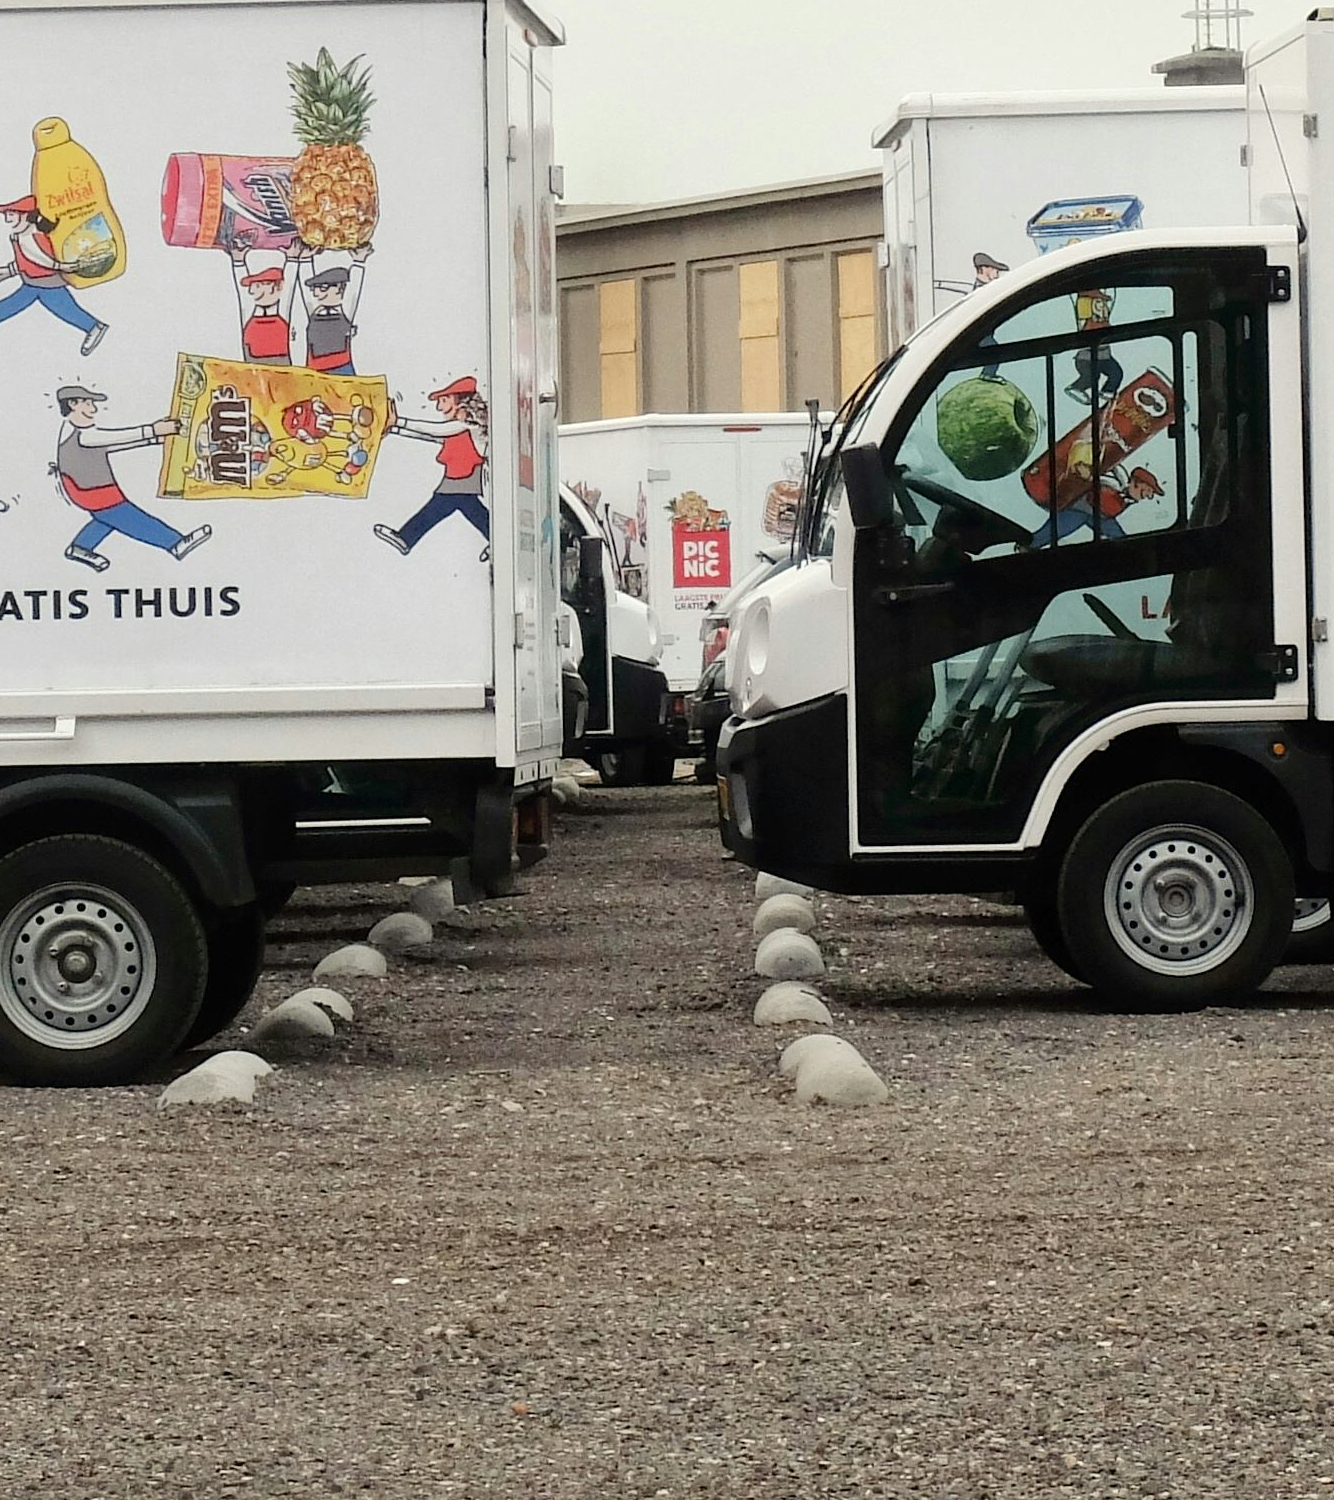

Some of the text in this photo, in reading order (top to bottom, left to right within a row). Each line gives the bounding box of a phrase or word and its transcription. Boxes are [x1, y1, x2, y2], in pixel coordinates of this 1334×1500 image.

[243, 174, 298, 234] Vanish
[682, 540, 720, 559] PIC
[105, 586, 241, 619] THUIS
